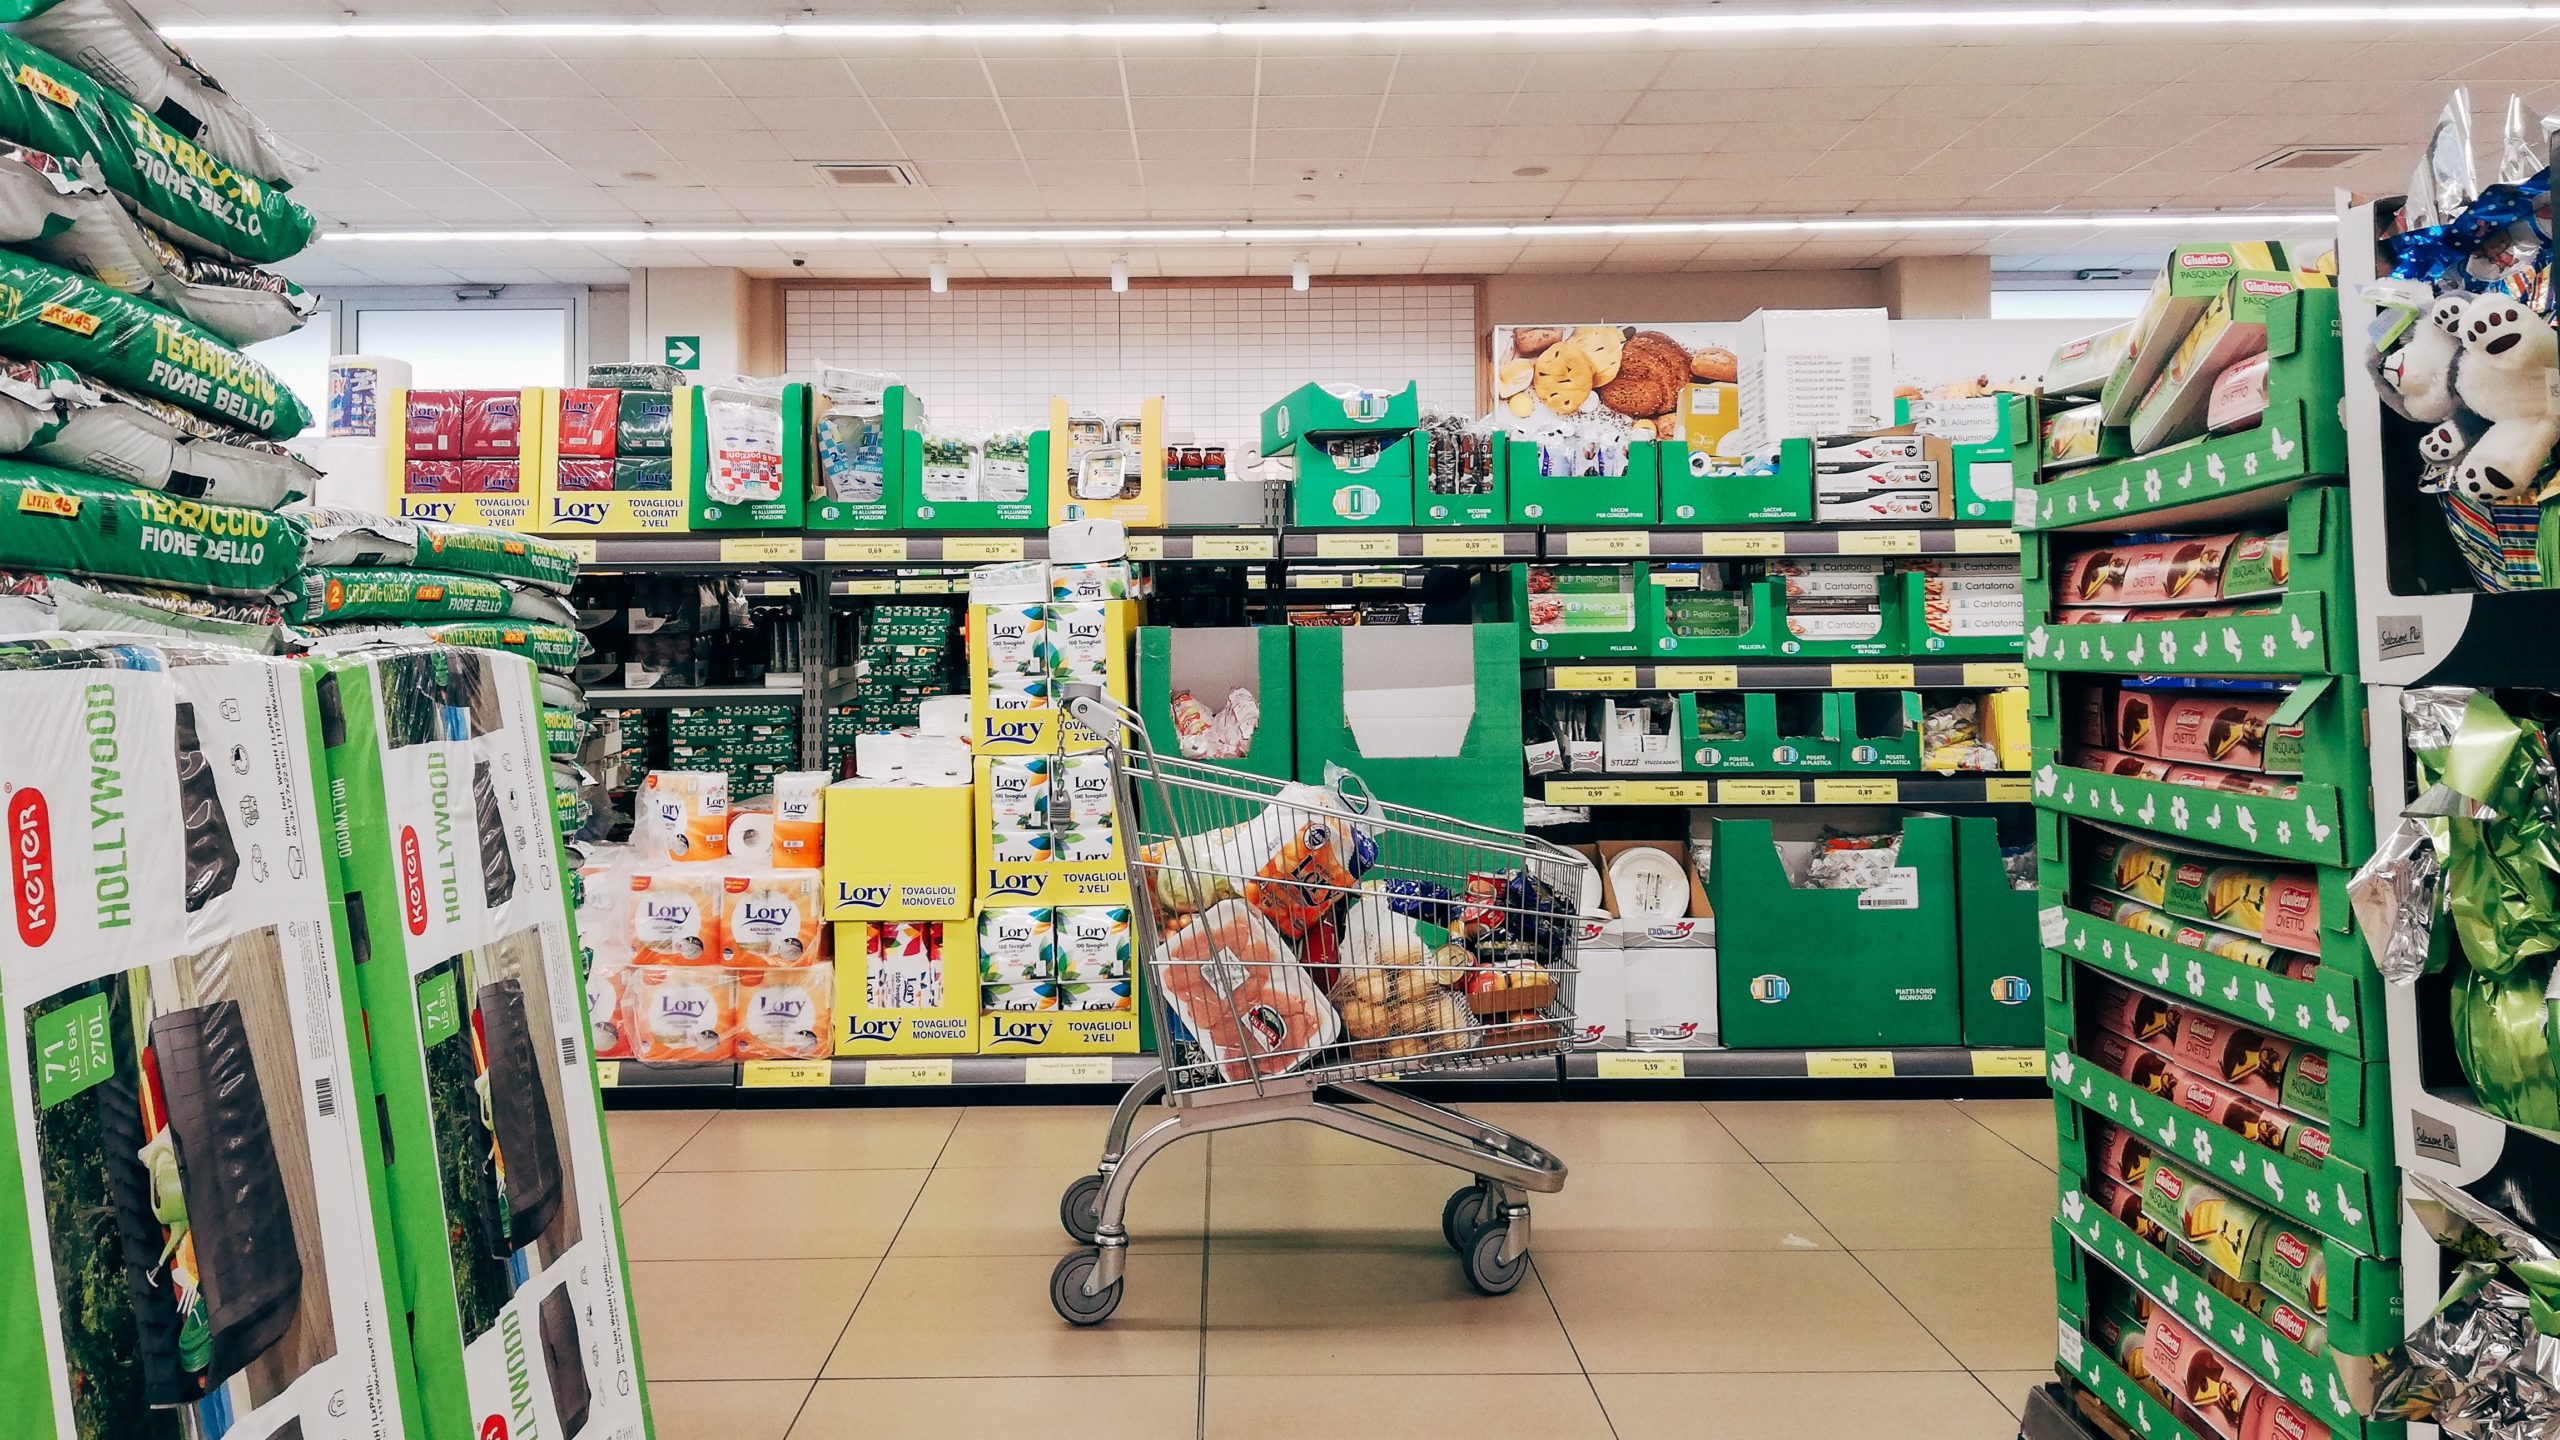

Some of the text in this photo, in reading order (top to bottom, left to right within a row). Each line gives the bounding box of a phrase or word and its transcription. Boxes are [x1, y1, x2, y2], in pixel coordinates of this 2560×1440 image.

[132, 148, 262, 236] FIORE BELLO
[2182, 254, 2230, 267] Giulietta
[2244, 282, 2292, 294] Giulietta
[152, 320, 276, 405] TERRICCIO
[148, 359, 275, 431] FIORE BELLO
[487, 399, 517, 415] Lory
[564, 399, 596, 414] Lory
[1950, 402, 1990, 410] Alluminio
[1951, 417, 1991, 426] Alluminio
[411, 472, 443, 489] Lory
[483, 474, 516, 492] Lory
[559, 472, 592, 489] Lory
[637, 470, 669, 486] Lory
[400, 497, 456, 523] Lory
[475, 499, 530, 508] TOVAGLIOLI
[549, 497, 610, 524] Lory
[628, 499, 683, 508] TOVAGLIOLI
[131, 489, 268, 538] TERRICCIO
[479, 509, 525, 517] COLORATI
[633, 509, 678, 518] COLORATI
[488, 519, 515, 527] 2 VELI
[642, 519, 668, 528] 2 VELI
[140, 526, 265, 566] FIORE BELLO
[1823, 562, 1872, 572] Cartaforno
[1963, 562, 2013, 571] Cartaforno
[1576, 575, 1612, 583] Pellicola
[1824, 582, 1873, 591] Cartaforno
[1965, 581, 2015, 590] Cartaforno
[330, 586, 340, 603] 2
[1076, 586, 1101, 597] Lory
[449, 598, 502, 612] FIORE BELLO
[1973, 600, 2023, 608] Cartaforno
[1692, 610, 1729, 619] Pellicola
[992, 623, 1025, 639] Lory
[1068, 622, 1102, 639] Lory
[1693, 627, 1729, 635] Pellicola
[1827, 620, 1876, 630] Cartaforno
[1974, 619, 2023, 628] Cartaforno
[996, 698, 1028, 710] Lory
[982, 717, 1043, 747] Lory
[2173, 733, 2197, 744] OVETTO
[994, 775, 1028, 791] Lory
[1075, 776, 1108, 792] Lory
[84, 683, 131, 929] HOLLYWOOD
[706, 796, 725, 809] Lory
[783, 801, 808, 814] Lory
[331, 777, 353, 858] HOLLYWOOD
[428, 752, 461, 924] HOLLYWOOD
[20, 804, 47, 930] KETER
[404, 837, 424, 924] KETER
[986, 870, 1048, 898] Lory
[1063, 872, 1126, 882] TOVAGLIOLI
[834, 882, 892, 910] Lory
[901, 886, 956, 896] TOVAGLIOLI
[1079, 884, 1109, 893] 2 VELI
[902, 896, 955, 906] MONOVELO
[2279, 891, 2310, 910] Giulietta
[647, 901, 692, 923] Lory
[741, 904, 792, 927] Lory
[2276, 914, 2305, 930] OVETTO
[998, 925, 1032, 941] Lory
[1076, 925, 1109, 941] Lory
[904, 977, 916, 1005] Lory
[662, 995, 709, 1018] Lory
[426, 1000, 441, 1030] 71
[844, 1015, 902, 1044] Lory
[912, 1019, 967, 1029] TOVAGLIOLI
[988, 1016, 1052, 1046] Lory
[1068, 1020, 1132, 1032] TOVAGLIOLI
[89, 1004, 108, 1069] 270L
[912, 1029, 966, 1039] MONOVELO
[1084, 1032, 1115, 1042] 2 VELI
[66, 1018, 81, 1083] US Gal
[2186, 1044, 2211, 1059] OVETTO
[45, 1039, 68, 1084] 71
[911, 1070, 926, 1078] 1,49
[2300, 1129, 2330, 1154] Giulietta
[2155, 1171, 2182, 1194] Giulietta
[2275, 1236, 2306, 1262] Giulietta
[2274, 1308, 2306, 1338] Giulietta
[2156, 1325, 2181, 1353] Giulietta
[2153, 1347, 2176, 1374] OVETTO
[2275, 1408, 2306, 1439] Giulietta
